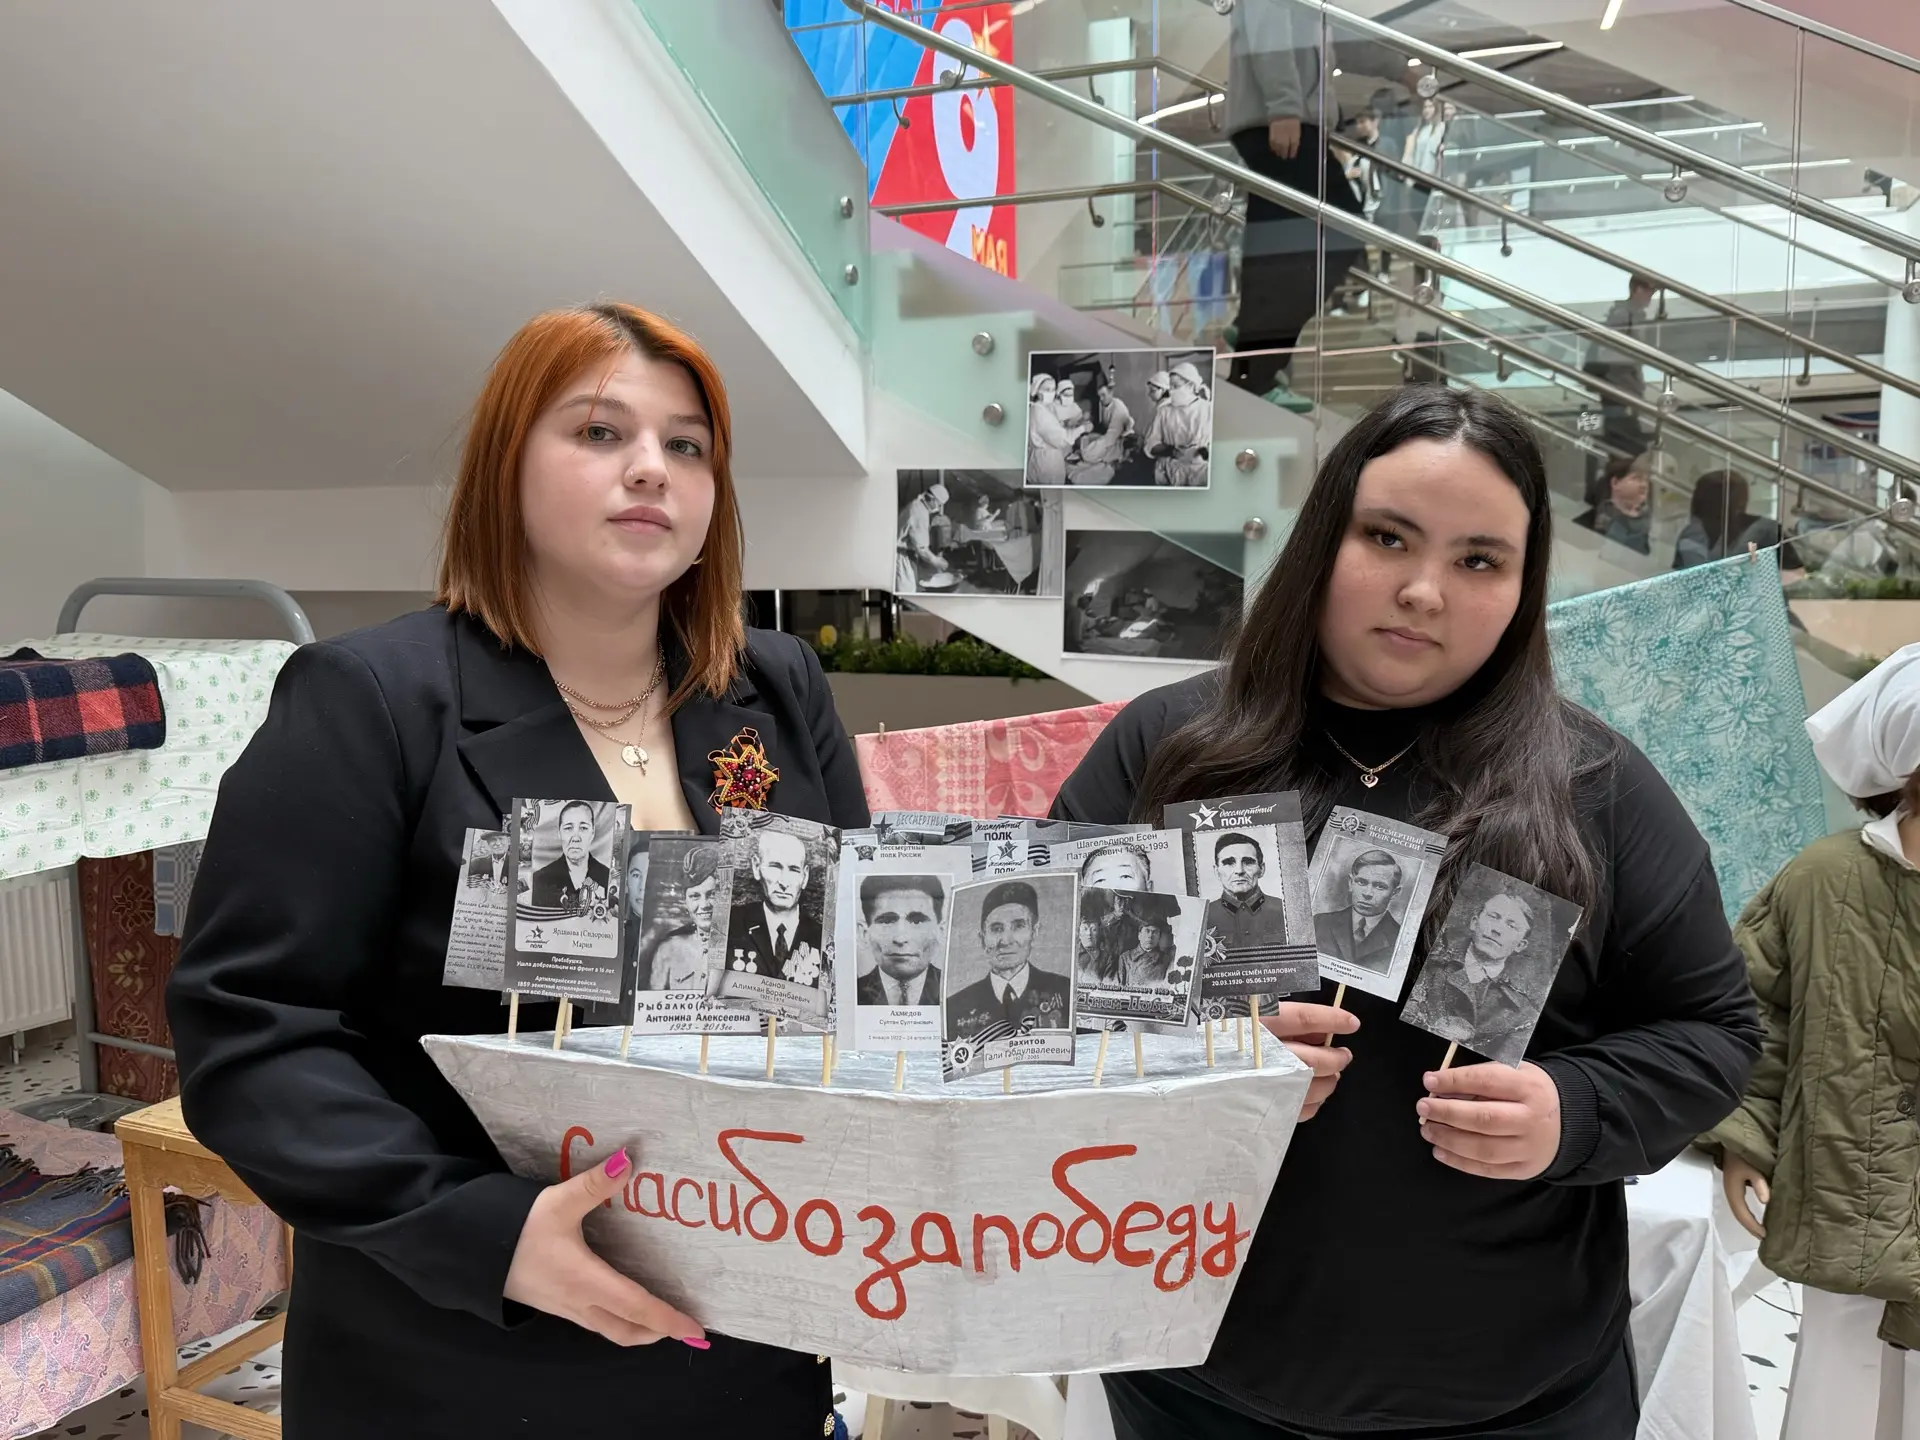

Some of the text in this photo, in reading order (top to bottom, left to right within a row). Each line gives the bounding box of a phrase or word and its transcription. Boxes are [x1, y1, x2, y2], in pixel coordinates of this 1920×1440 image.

[971, 224, 1008, 278] МАЯ
[1219, 800, 1278, 817] бессмертный
[895, 812, 949, 827] БЕССМЕРТНЫЙ
[1221, 816, 1252, 827] ПОЛК
[984, 831, 1012, 841] ПОЛК
[1076, 832, 1158, 850] Шагельдиров Есен
[1369, 825, 1425, 846] БЕССМЕРТНЫЙ
[1369, 832, 1421, 851] ПОЛК РОССИИ
[1125, 841, 1169, 853] 1920-1993
[572, 940, 593, 949] Мария
[1202, 967, 1297, 979] ОВАЛЕВСКИЙ СЕМЁН ПАВЛОВИЧ
[761, 978, 786, 990] Асанов
[664, 993, 705, 1001] серж
[731, 982, 811, 1004] Алимхан Боранбаевич
[646, 1013, 750, 1022] Антонина Алексеевна
[890, 1010, 921, 1018] Ахмедов
[669, 1023, 692, 1031] 1923
[985, 1047, 1071, 1061] Гали Габдулвалеевич
[854, 1203, 962, 1321] за
[972, 1143, 1250, 1293] победу
